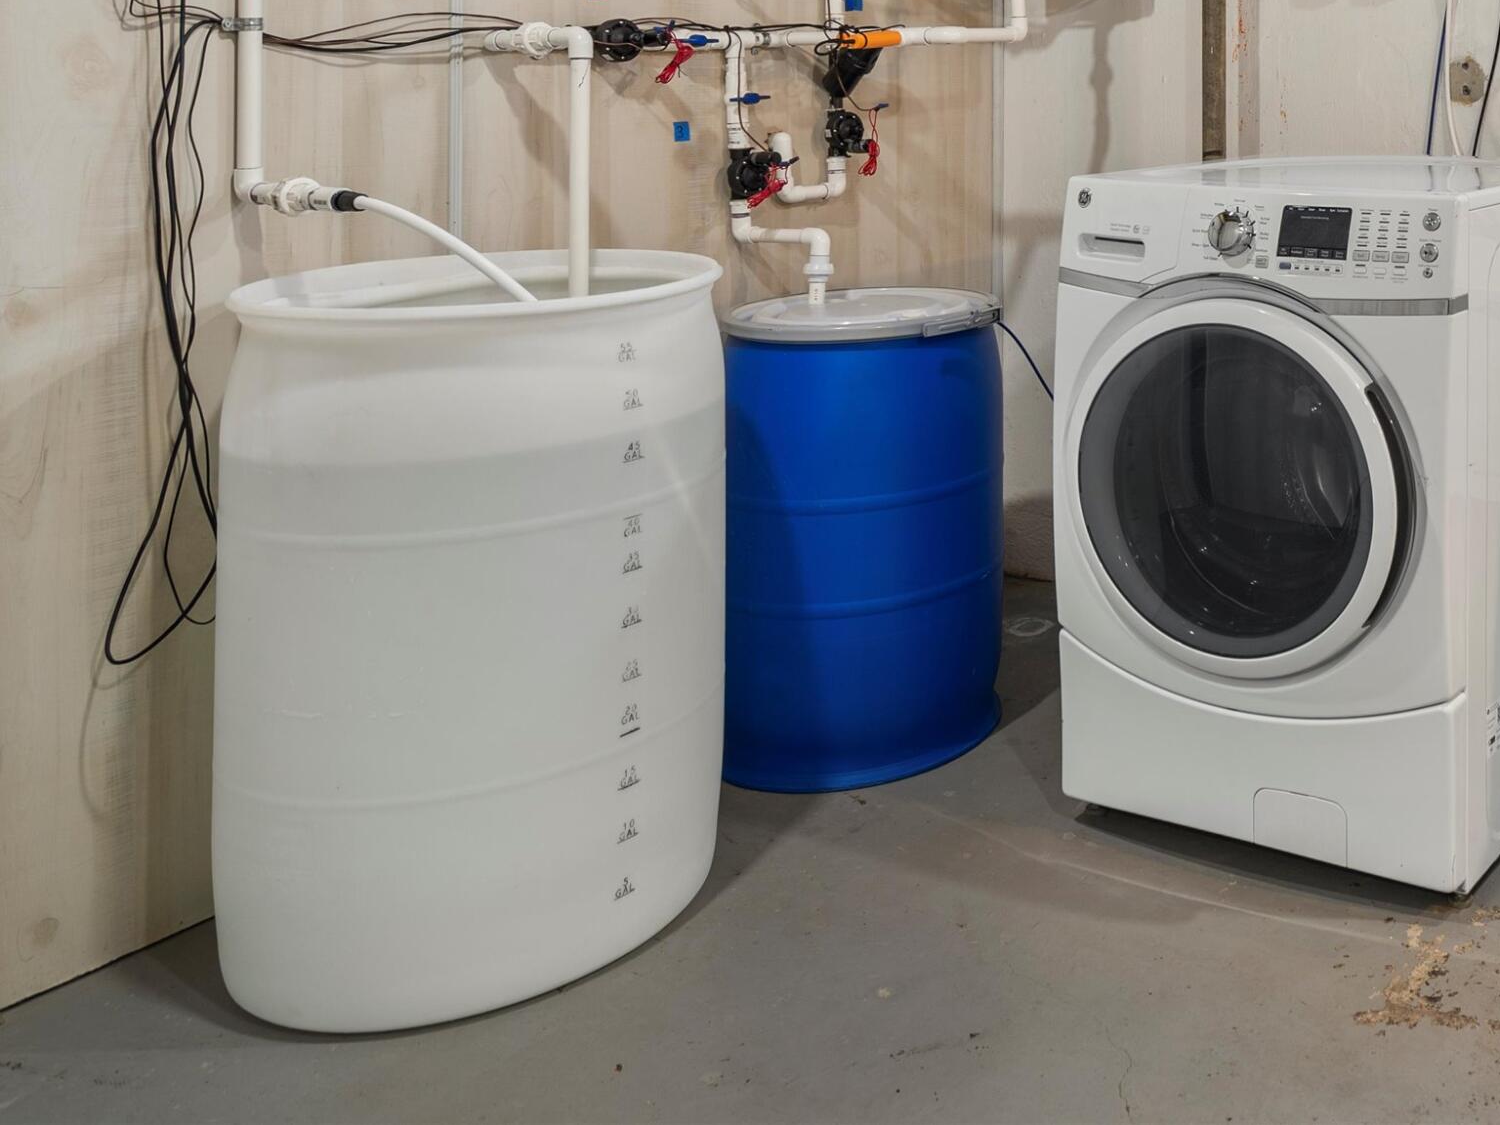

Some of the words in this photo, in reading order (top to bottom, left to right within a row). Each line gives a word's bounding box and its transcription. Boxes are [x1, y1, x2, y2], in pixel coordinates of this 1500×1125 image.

[618, 351, 637, 363] GAL
[624, 397, 643, 409] GAL
[624, 449, 644, 461] GAL
[624, 526, 643, 537] GAL
[624, 559, 643, 572] GAL
[622, 612, 642, 626] GAL
[622, 668, 642, 682] GAL
[620, 712, 640, 725] GAL
[620, 774, 640, 788] GAL
[618, 827, 638, 842] GAL
[614, 884, 636, 899] GAL
